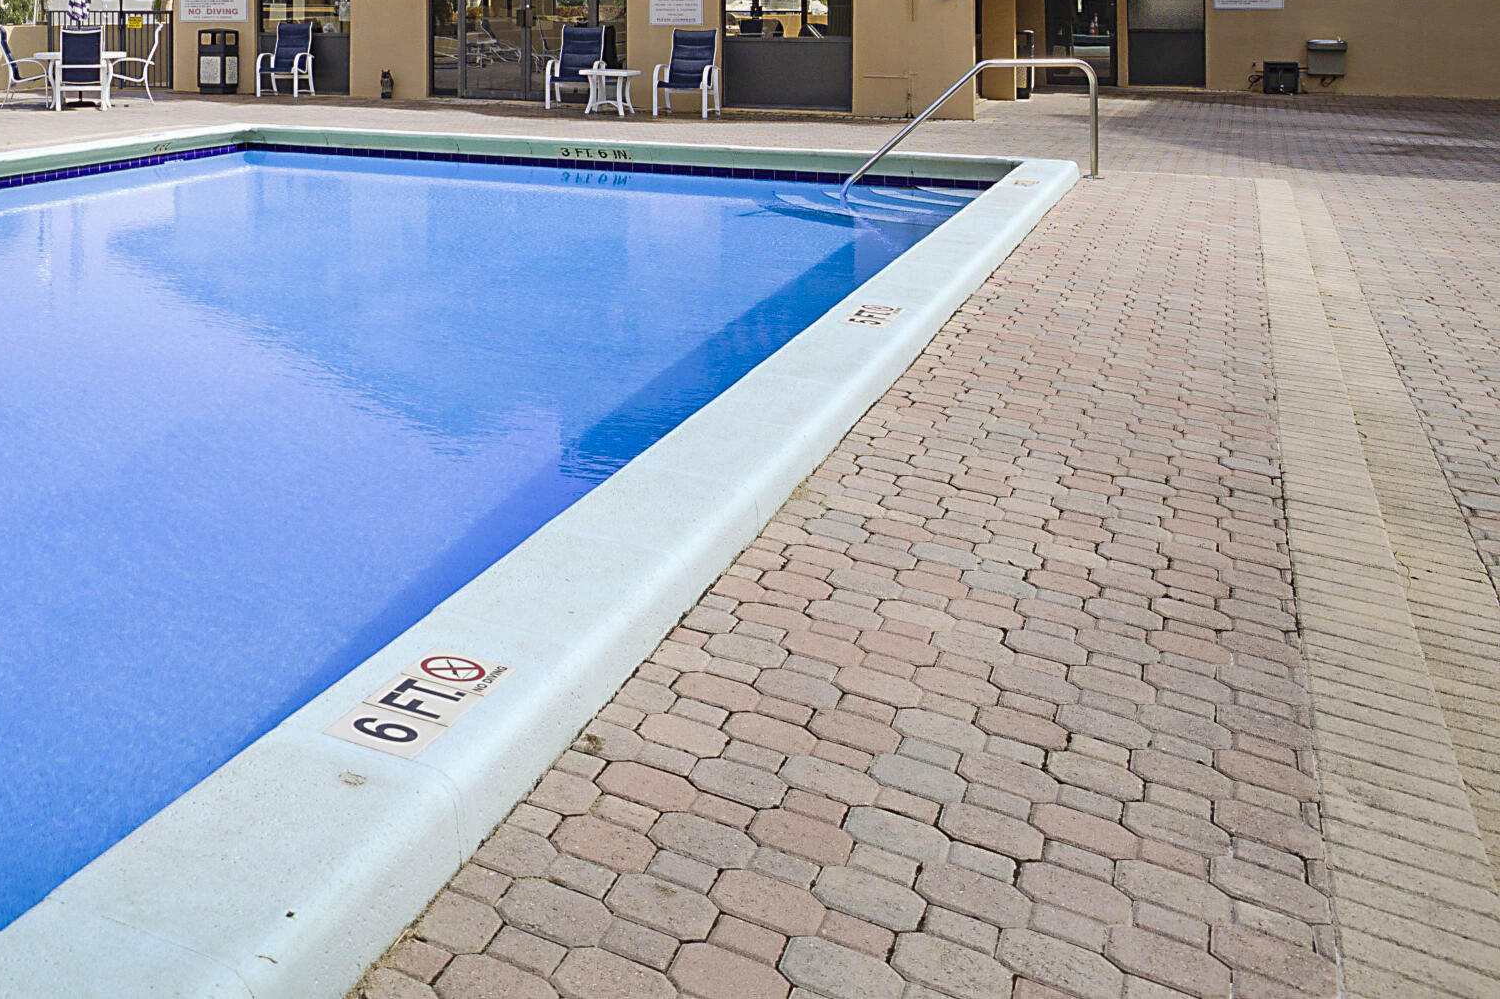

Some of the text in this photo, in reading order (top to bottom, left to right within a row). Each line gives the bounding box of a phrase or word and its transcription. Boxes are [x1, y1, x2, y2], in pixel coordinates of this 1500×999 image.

[560, 147, 632, 160] 3 FT. 6 IN.
[473, 665, 508, 693] NO DIVING
[353, 678, 467, 743] 6 FT.
